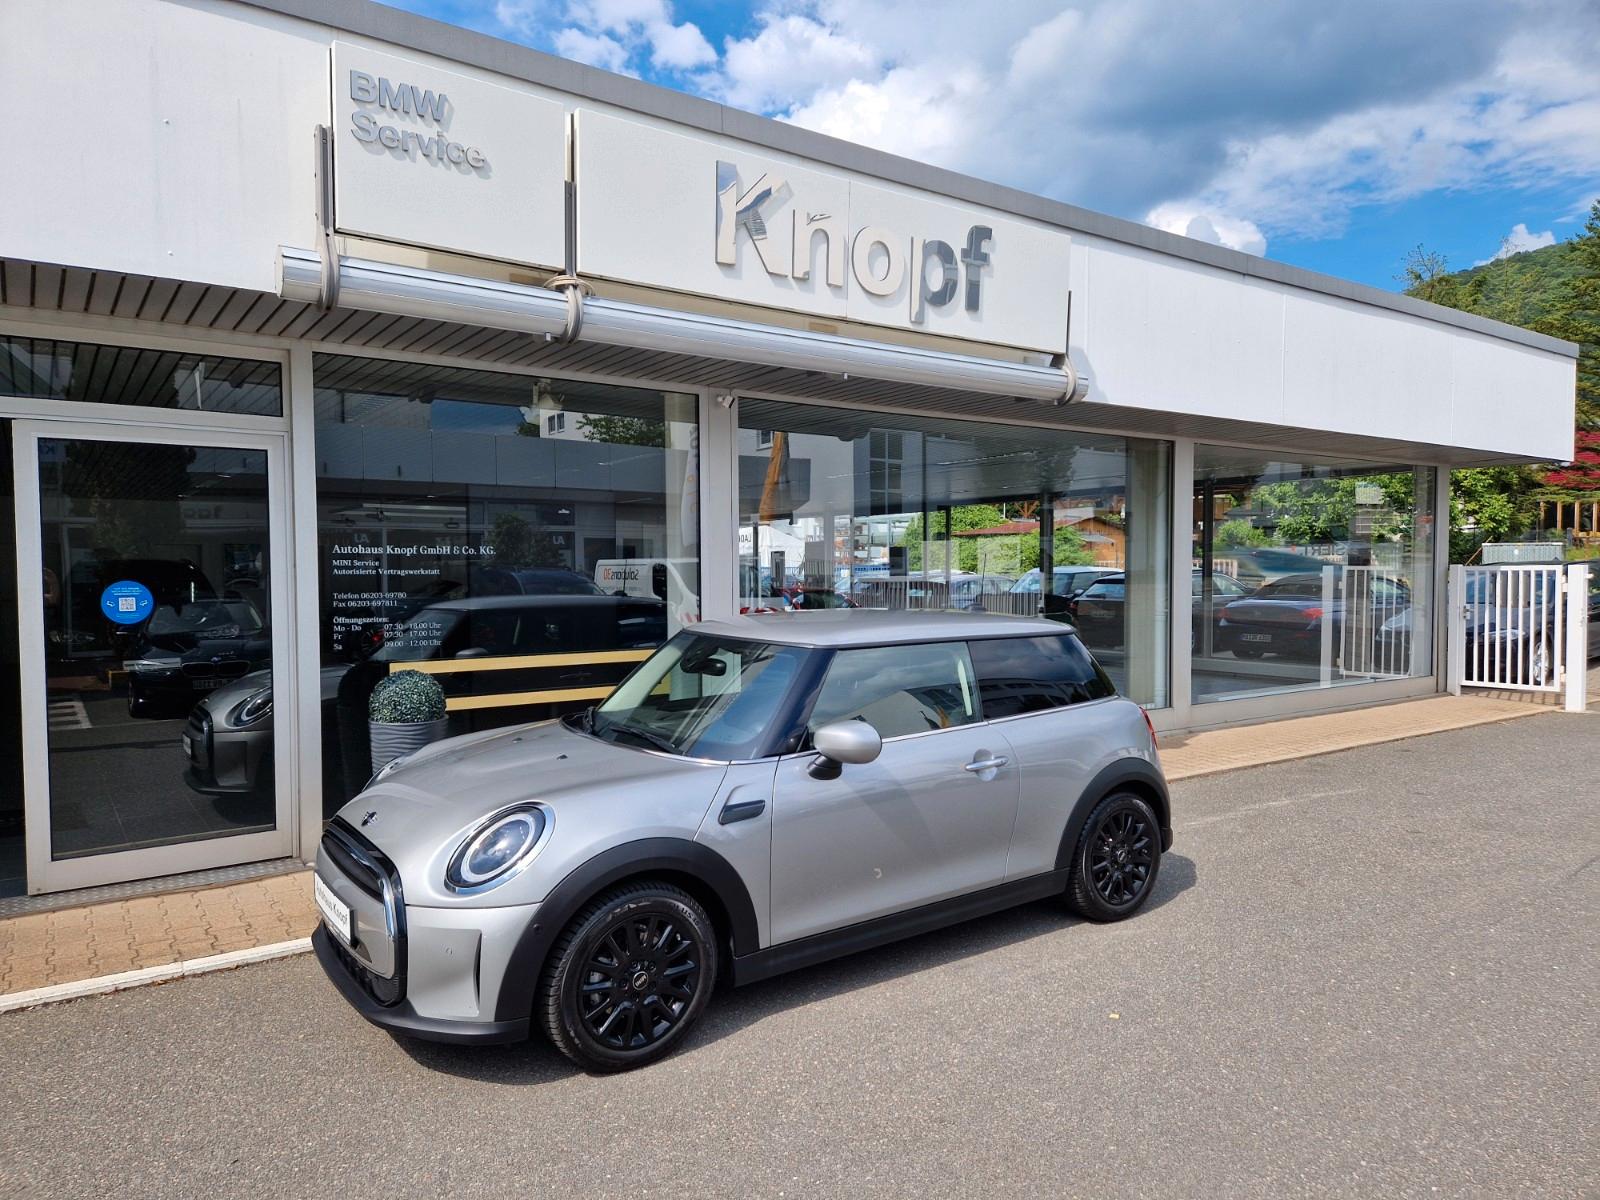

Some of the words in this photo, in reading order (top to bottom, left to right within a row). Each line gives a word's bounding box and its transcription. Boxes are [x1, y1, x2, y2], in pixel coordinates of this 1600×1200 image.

[350, 69, 448, 121] BMW
[350, 109, 486, 168] Service
[715, 159, 993, 324] Knopf
[332, 544, 384, 554] Autohaus
[386, 545, 418, 556] Knopf
[420, 545, 450, 555] GmbH
[453, 545, 460, 555] &
[479, 545, 497, 555] KG.
[332, 559, 352, 567] MINI
[353, 559, 380, 567] Service
[378, 568, 440, 577] Vertragswerkstatt
[332, 592, 360, 600] Telefon
[333, 600, 346, 608] Fax
